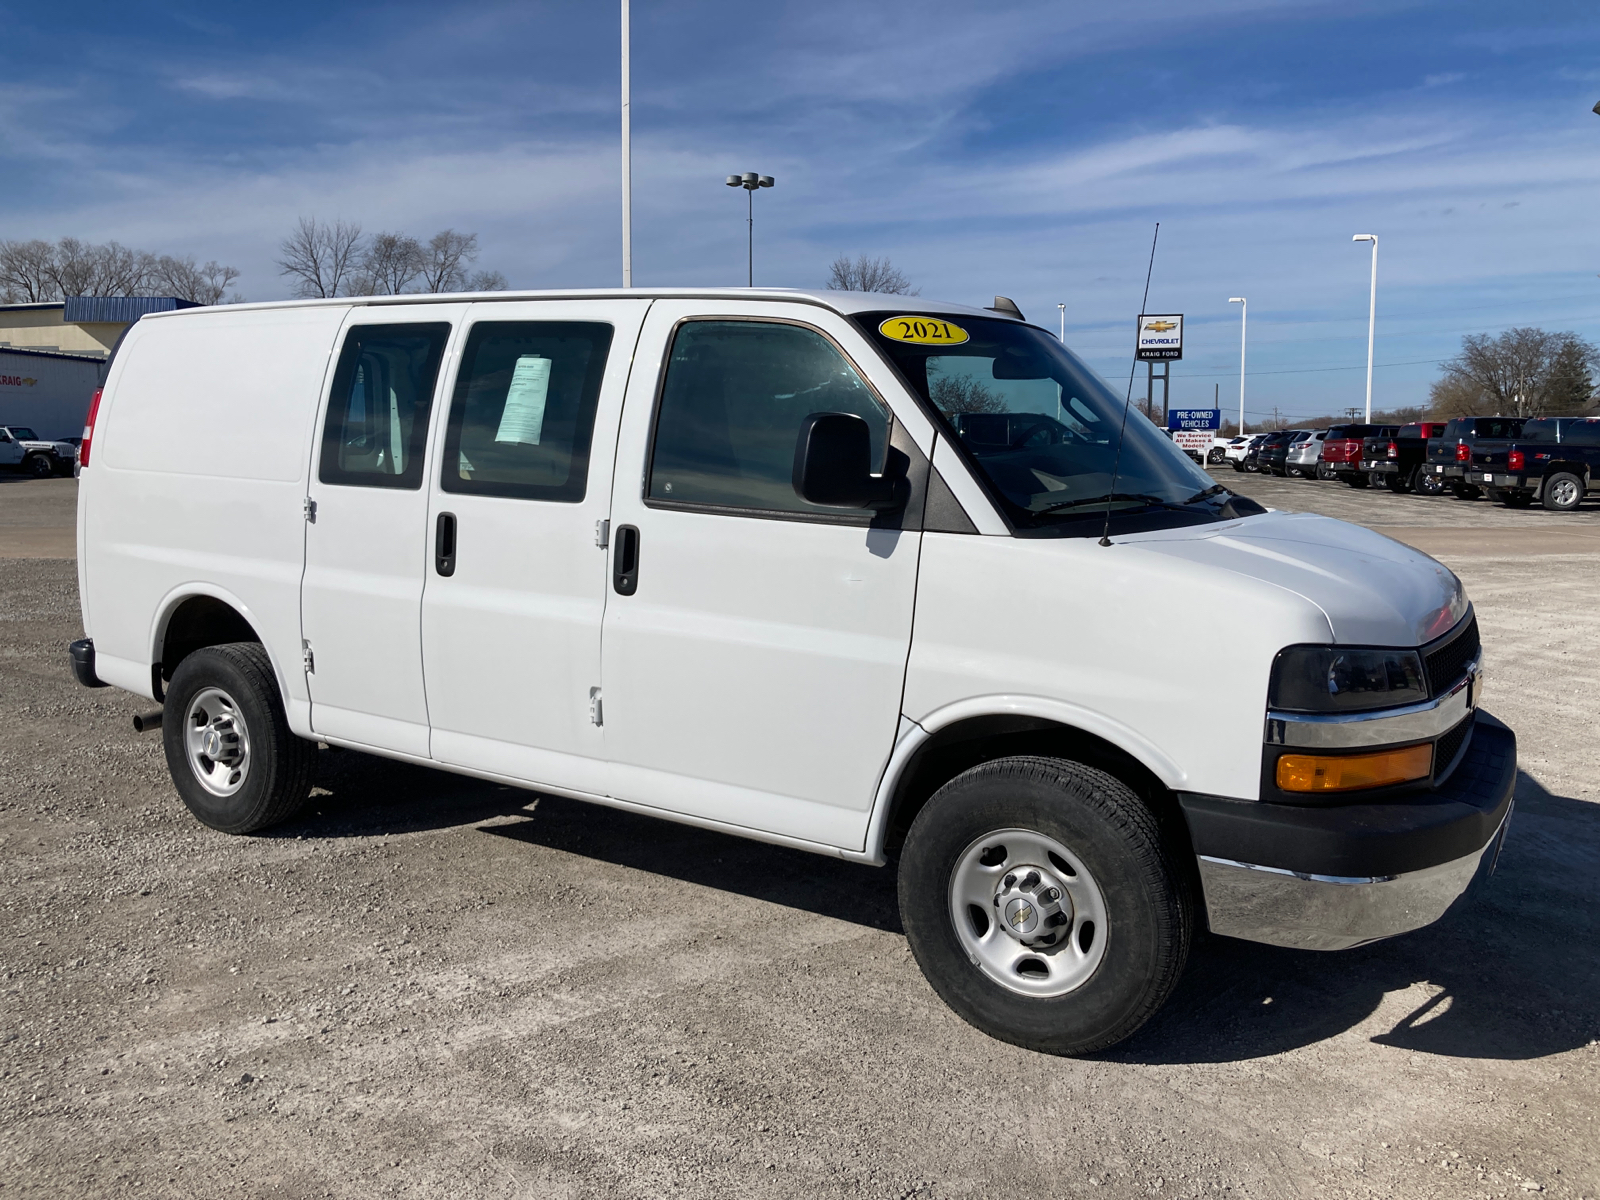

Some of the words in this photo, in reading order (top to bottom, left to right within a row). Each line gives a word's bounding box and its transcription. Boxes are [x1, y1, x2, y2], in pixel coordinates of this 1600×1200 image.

[898, 321, 954, 339] 2021
[1176, 411, 1214, 419] PRE-OWNED
[1180, 419, 1210, 428] VEHICLES
